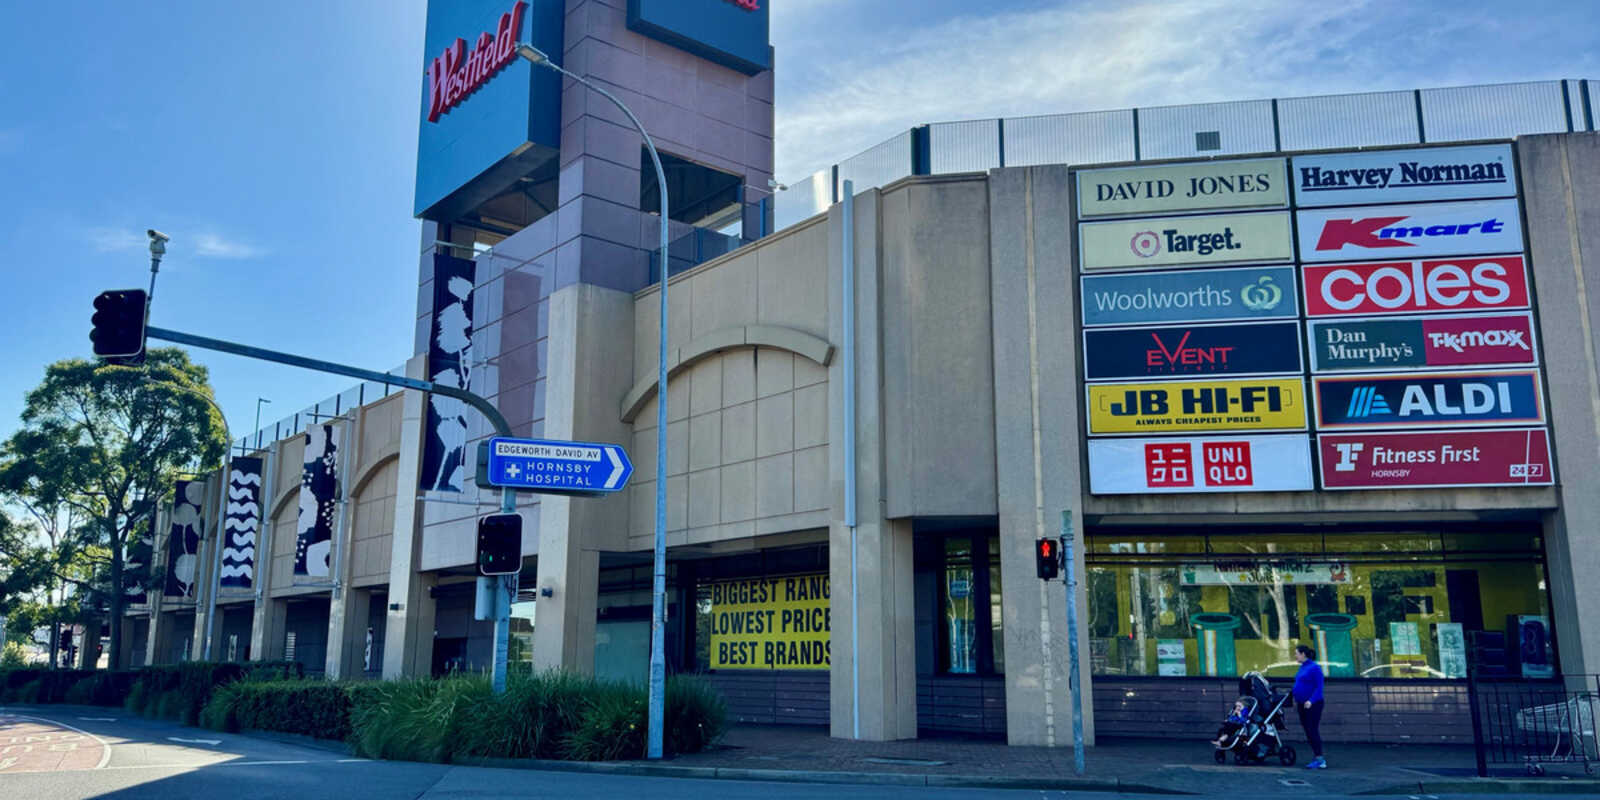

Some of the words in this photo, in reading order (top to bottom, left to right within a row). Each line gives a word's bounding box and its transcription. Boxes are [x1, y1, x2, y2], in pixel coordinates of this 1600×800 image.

[426, 1, 528, 123] Westfield
[1096, 179, 1175, 202] DAVID
[1186, 173, 1271, 198] JONES
[1300, 166, 1394, 188] Harvey
[1398, 162, 1506, 183] Norman
[1315, 215, 1505, 251] Kmart
[1094, 284, 1232, 311] Woolworths
[1320, 261, 1511, 311] coles
[1146, 330, 1234, 366] EVENT
[1326, 328, 1366, 344] Dan
[1328, 342, 1414, 363] Murphy's
[1110, 389, 1169, 417] JB
[1181, 386, 1282, 415] HI-FI
[1398, 382, 1513, 417] ALDI
[1135, 418, 1173, 427] ALWAYS
[1175, 417, 1223, 426] CHEAPEST
[1226, 416, 1262, 424] PRICES
[498, 444, 551, 456] EDGEWORTH
[555, 447, 583, 458] DAVID
[587, 450, 599, 460] AV
[1207, 447, 1242, 464] UNI
[525, 474, 592, 486] HOSPITAL
[527, 461, 592, 474] HORNSBY
[1209, 466, 1247, 484] QLO
[1371, 469, 1411, 478] HORNSBY
[713, 578, 779, 606] BIGGEST
[711, 609, 775, 635] LOWEST
[719, 641, 758, 665] BEST
